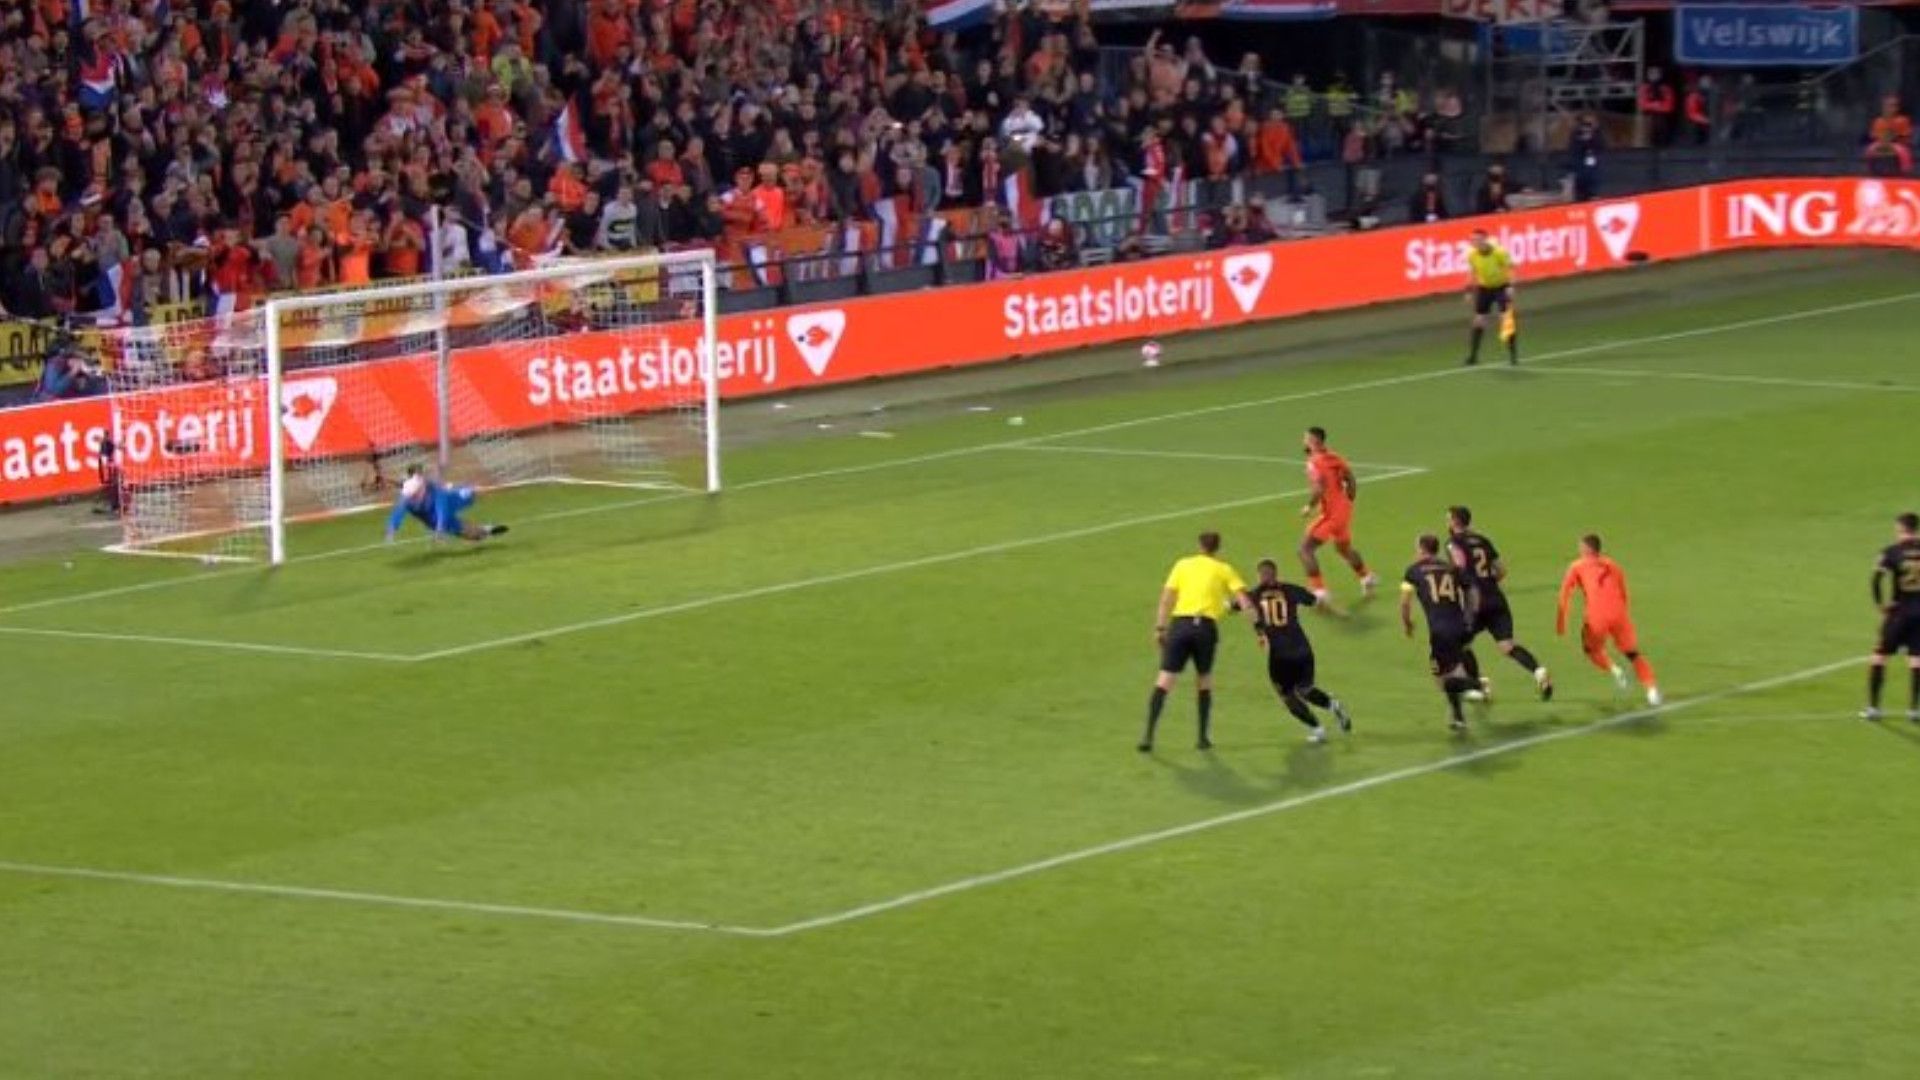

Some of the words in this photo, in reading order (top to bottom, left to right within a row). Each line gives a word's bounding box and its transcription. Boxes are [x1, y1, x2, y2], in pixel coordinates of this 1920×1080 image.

[1692, 16, 1844, 54] Velswijk
[1726, 190, 1839, 240] ING
[1405, 210, 1588, 281] Staaloterij
[1004, 259, 1214, 339] Staatsloterij
[0, 388, 254, 481] aatsloterij
[1472, 547, 1489, 578] 2
[1424, 573, 1456, 602] 14
[1260, 598, 1288, 627] 10
